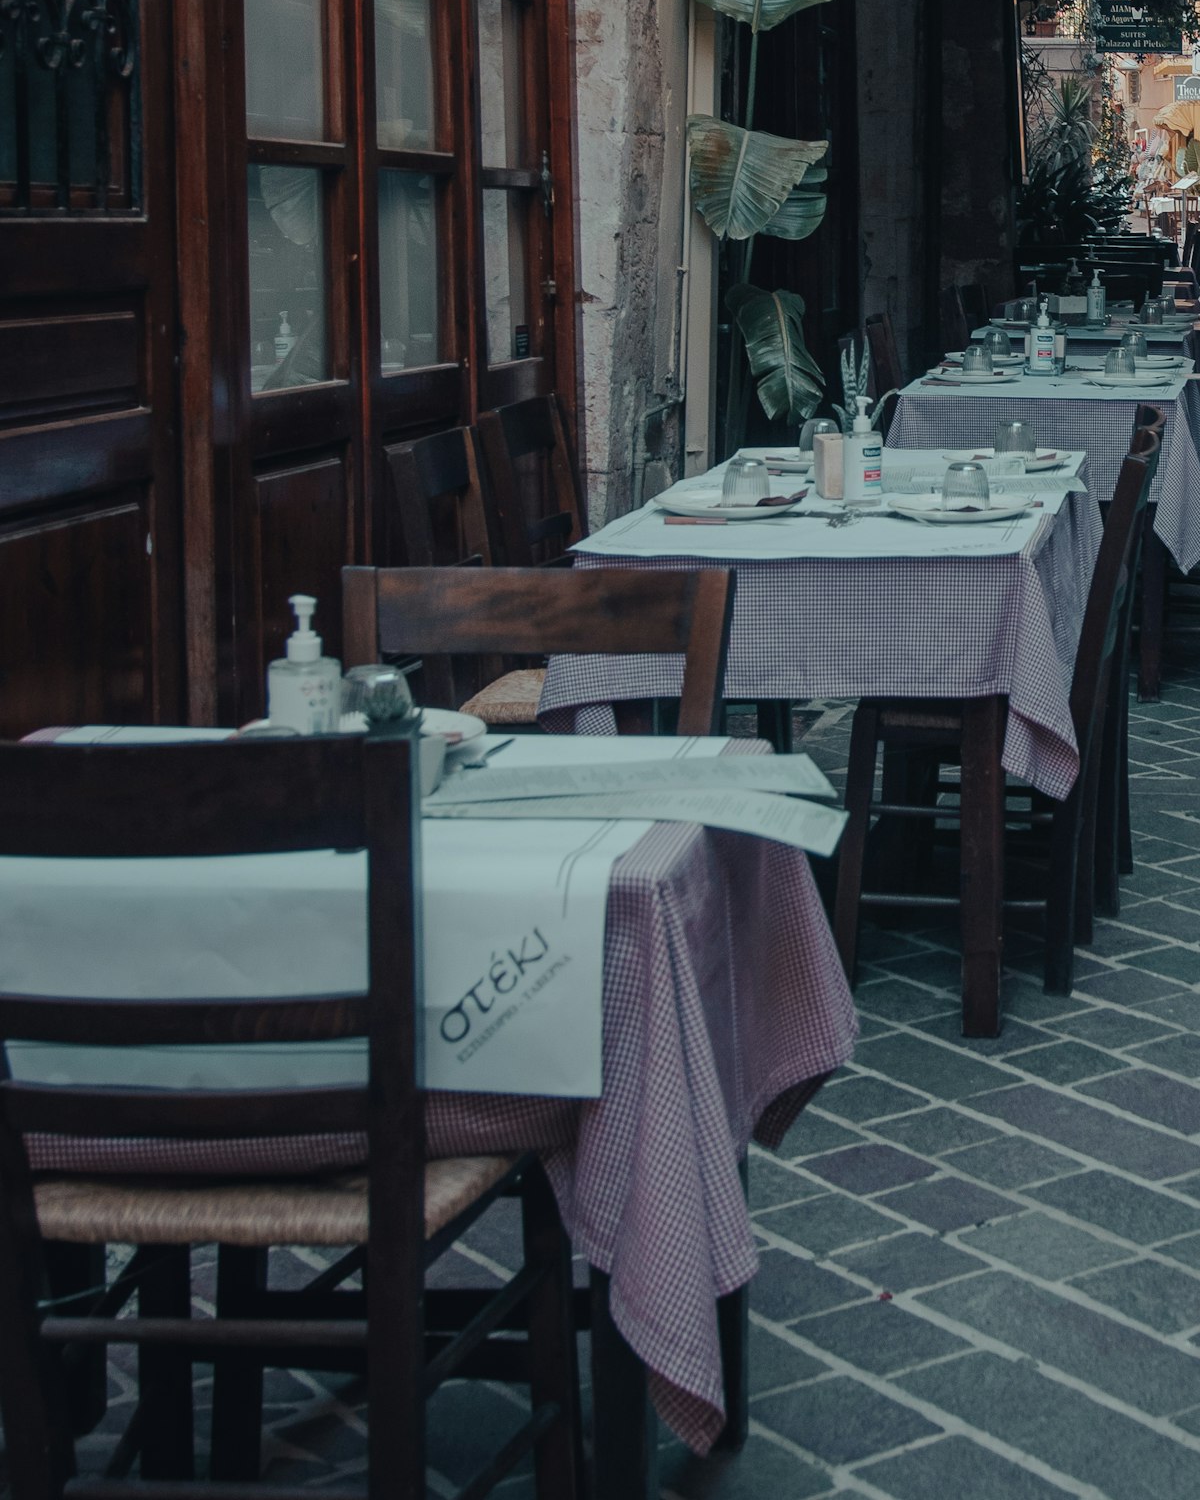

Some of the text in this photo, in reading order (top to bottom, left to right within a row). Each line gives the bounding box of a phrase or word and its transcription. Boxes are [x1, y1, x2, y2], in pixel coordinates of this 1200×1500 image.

[1120, 31, 1147, 39] SUITES
[1132, 39, 1141, 48] di
[440, 927, 549, 1044] στέκι
